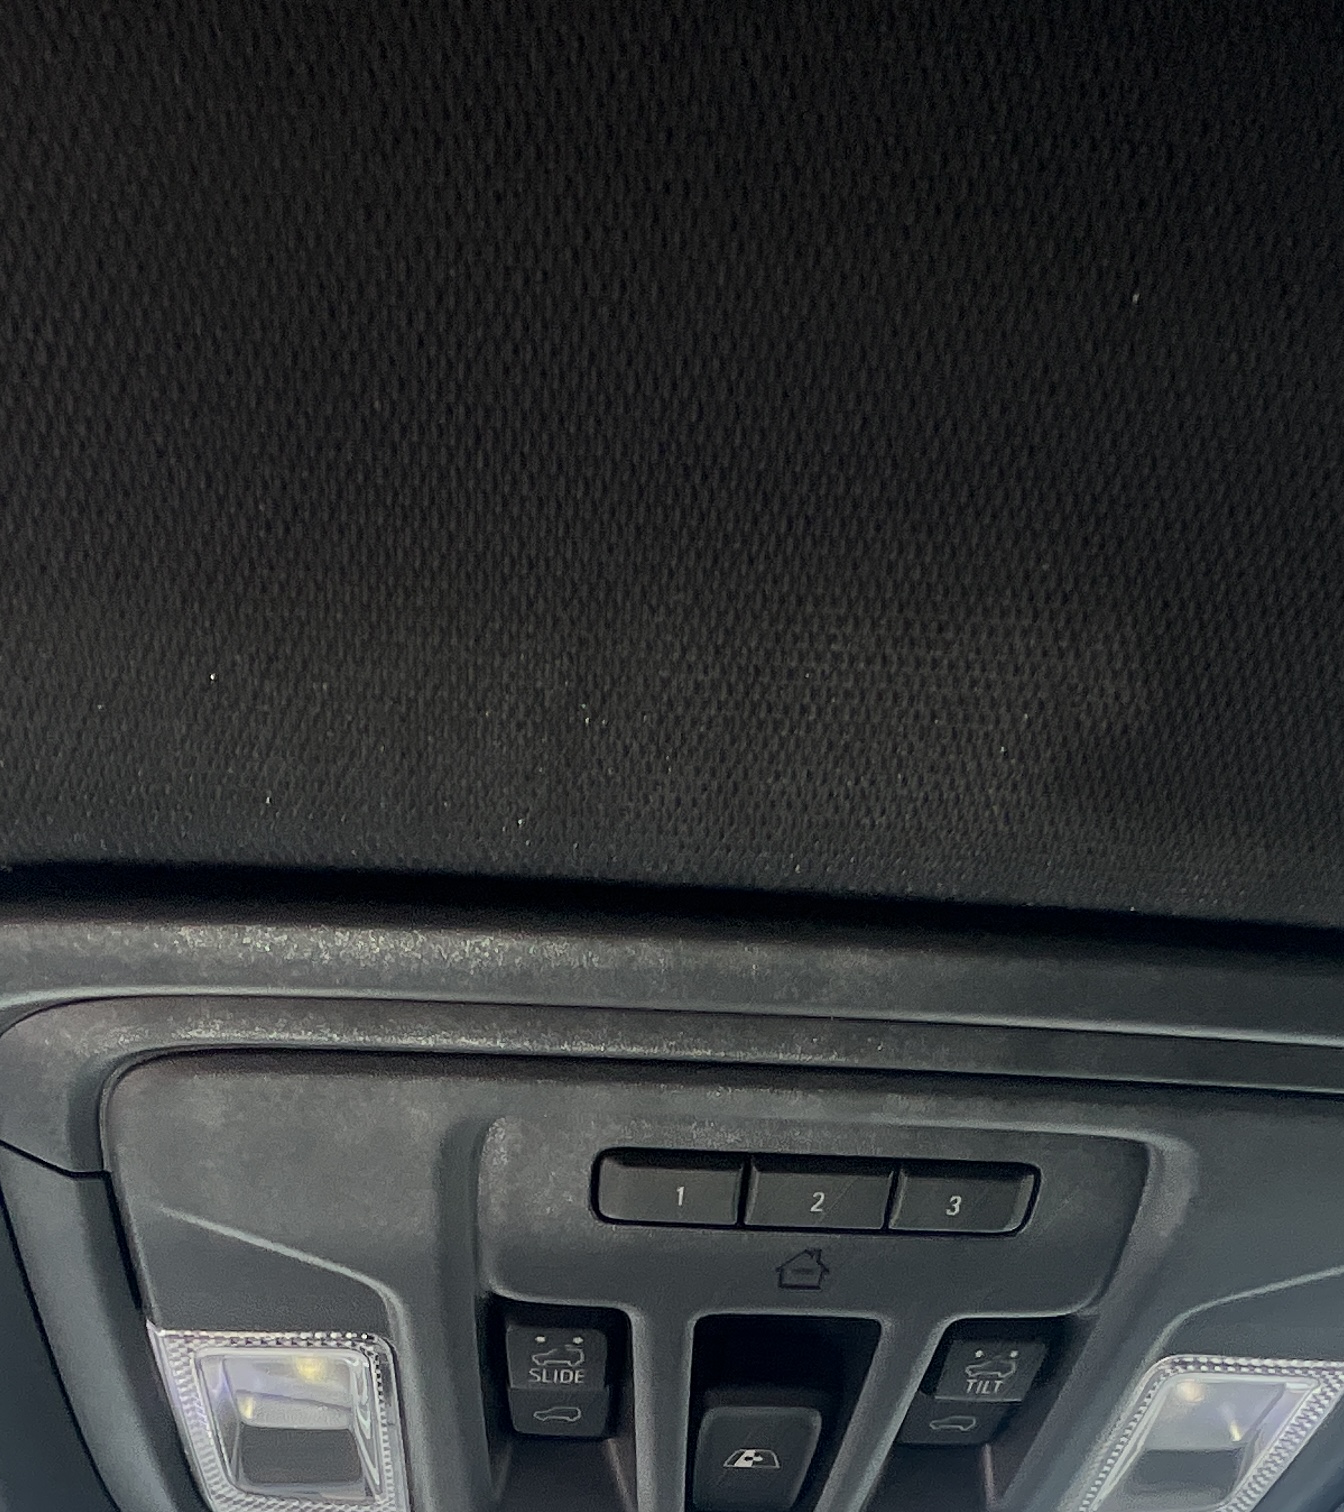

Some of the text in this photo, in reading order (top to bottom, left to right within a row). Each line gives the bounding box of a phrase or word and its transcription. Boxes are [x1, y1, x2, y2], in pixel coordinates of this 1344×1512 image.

[676, 1186, 962, 1216] 1 2 3
[528, 1368, 585, 1384] SLIDE
[966, 1379, 1004, 1394] TILT
